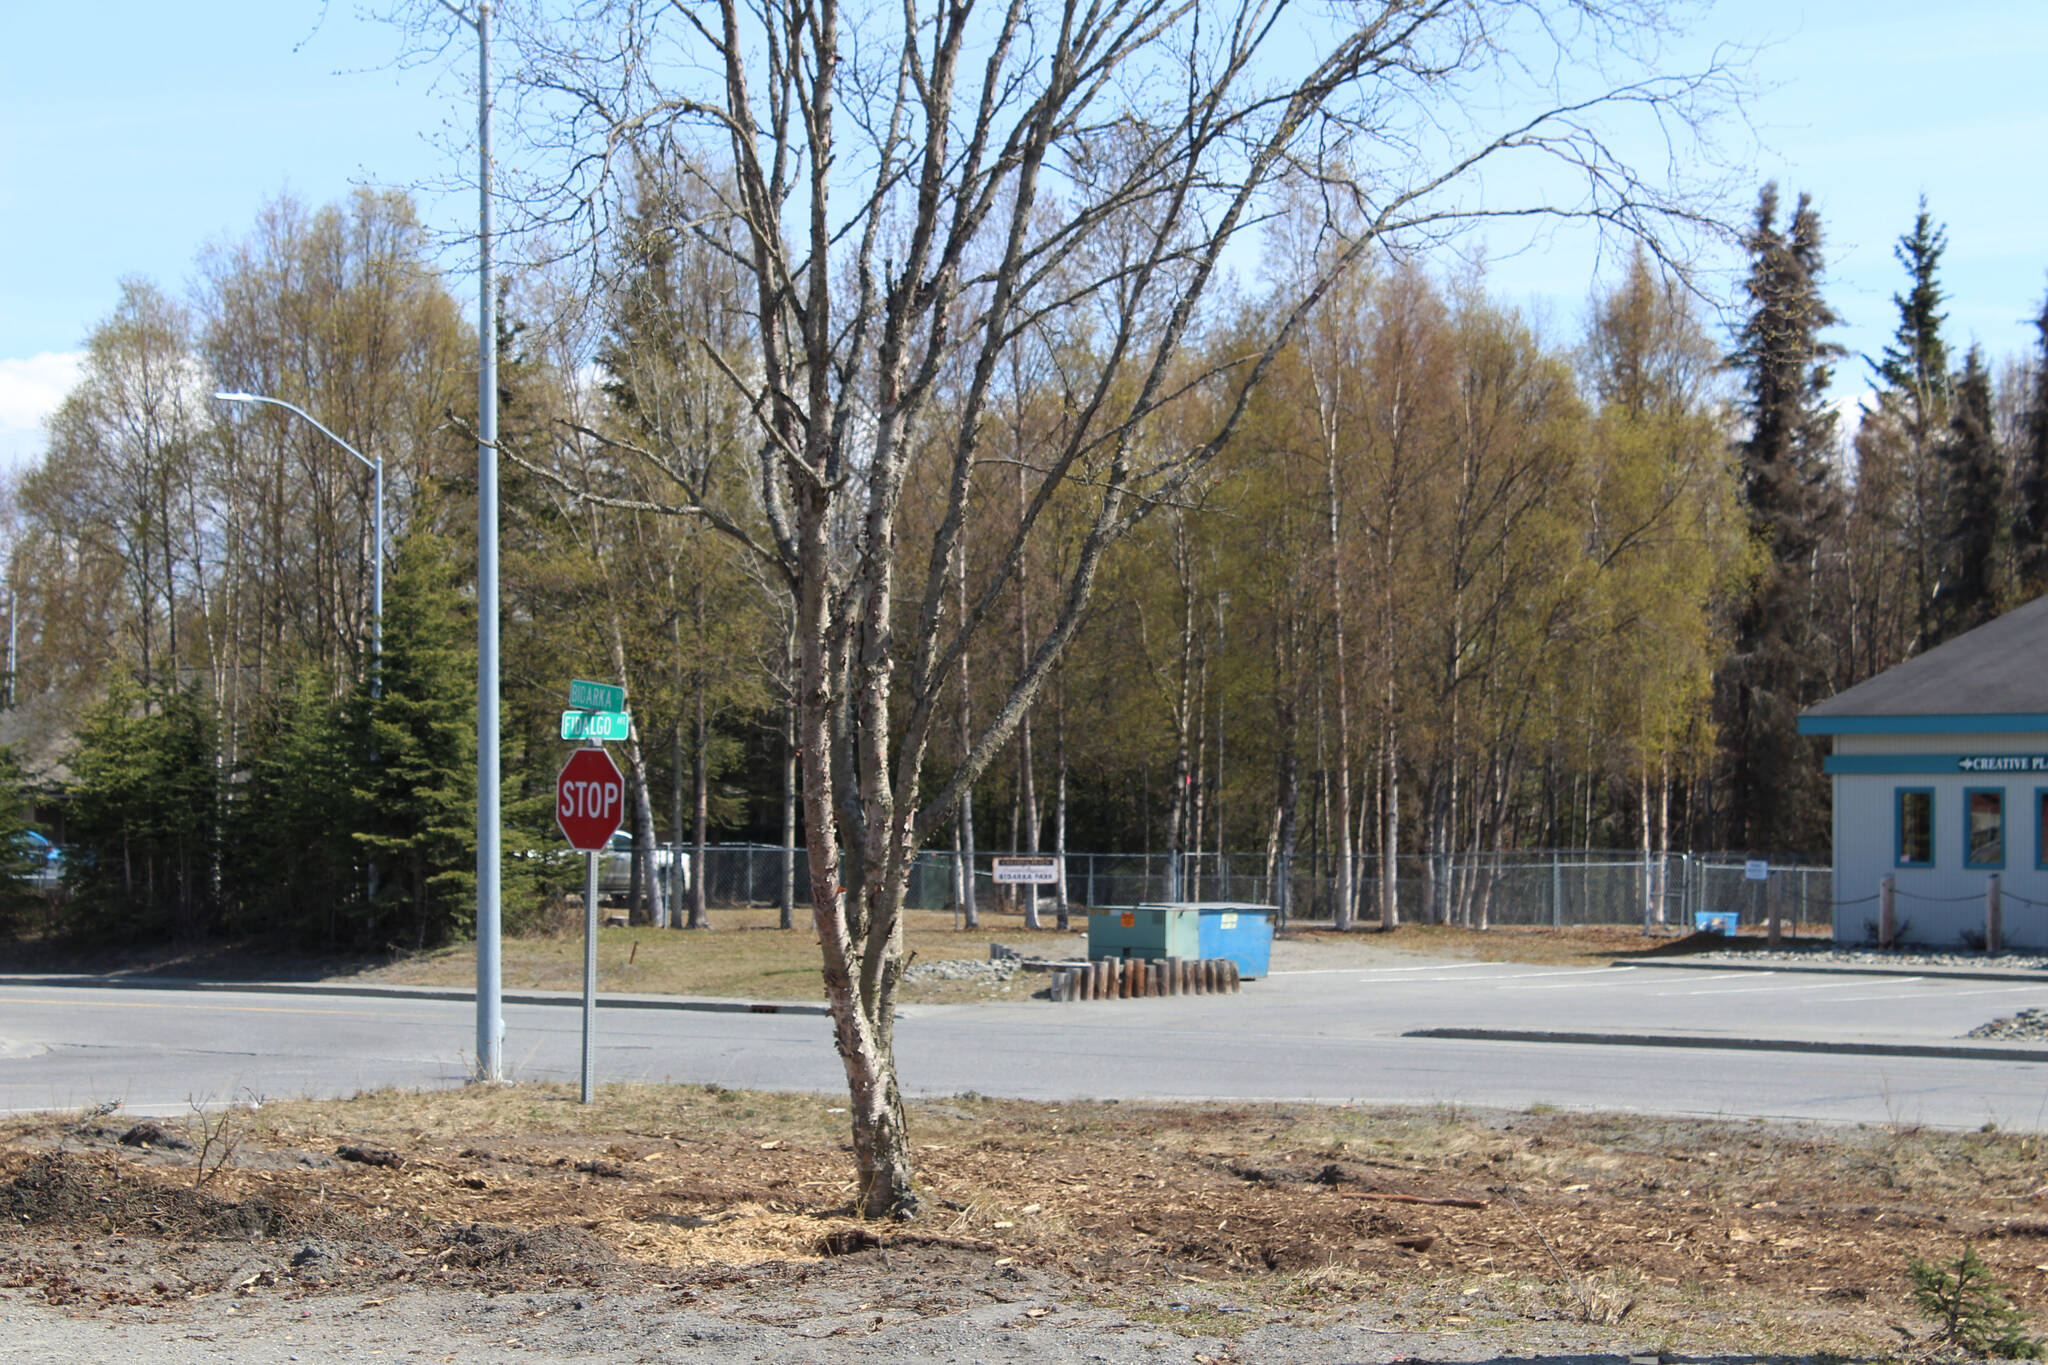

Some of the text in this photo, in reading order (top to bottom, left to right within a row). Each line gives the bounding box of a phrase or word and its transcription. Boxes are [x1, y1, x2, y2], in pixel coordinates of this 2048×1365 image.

[571, 684, 611, 709] BIDARKA
[563, 716, 626, 735] FIDALGO AVE
[1973, 757, 2029, 770] CREATIVE
[561, 780, 619, 819] STOP
